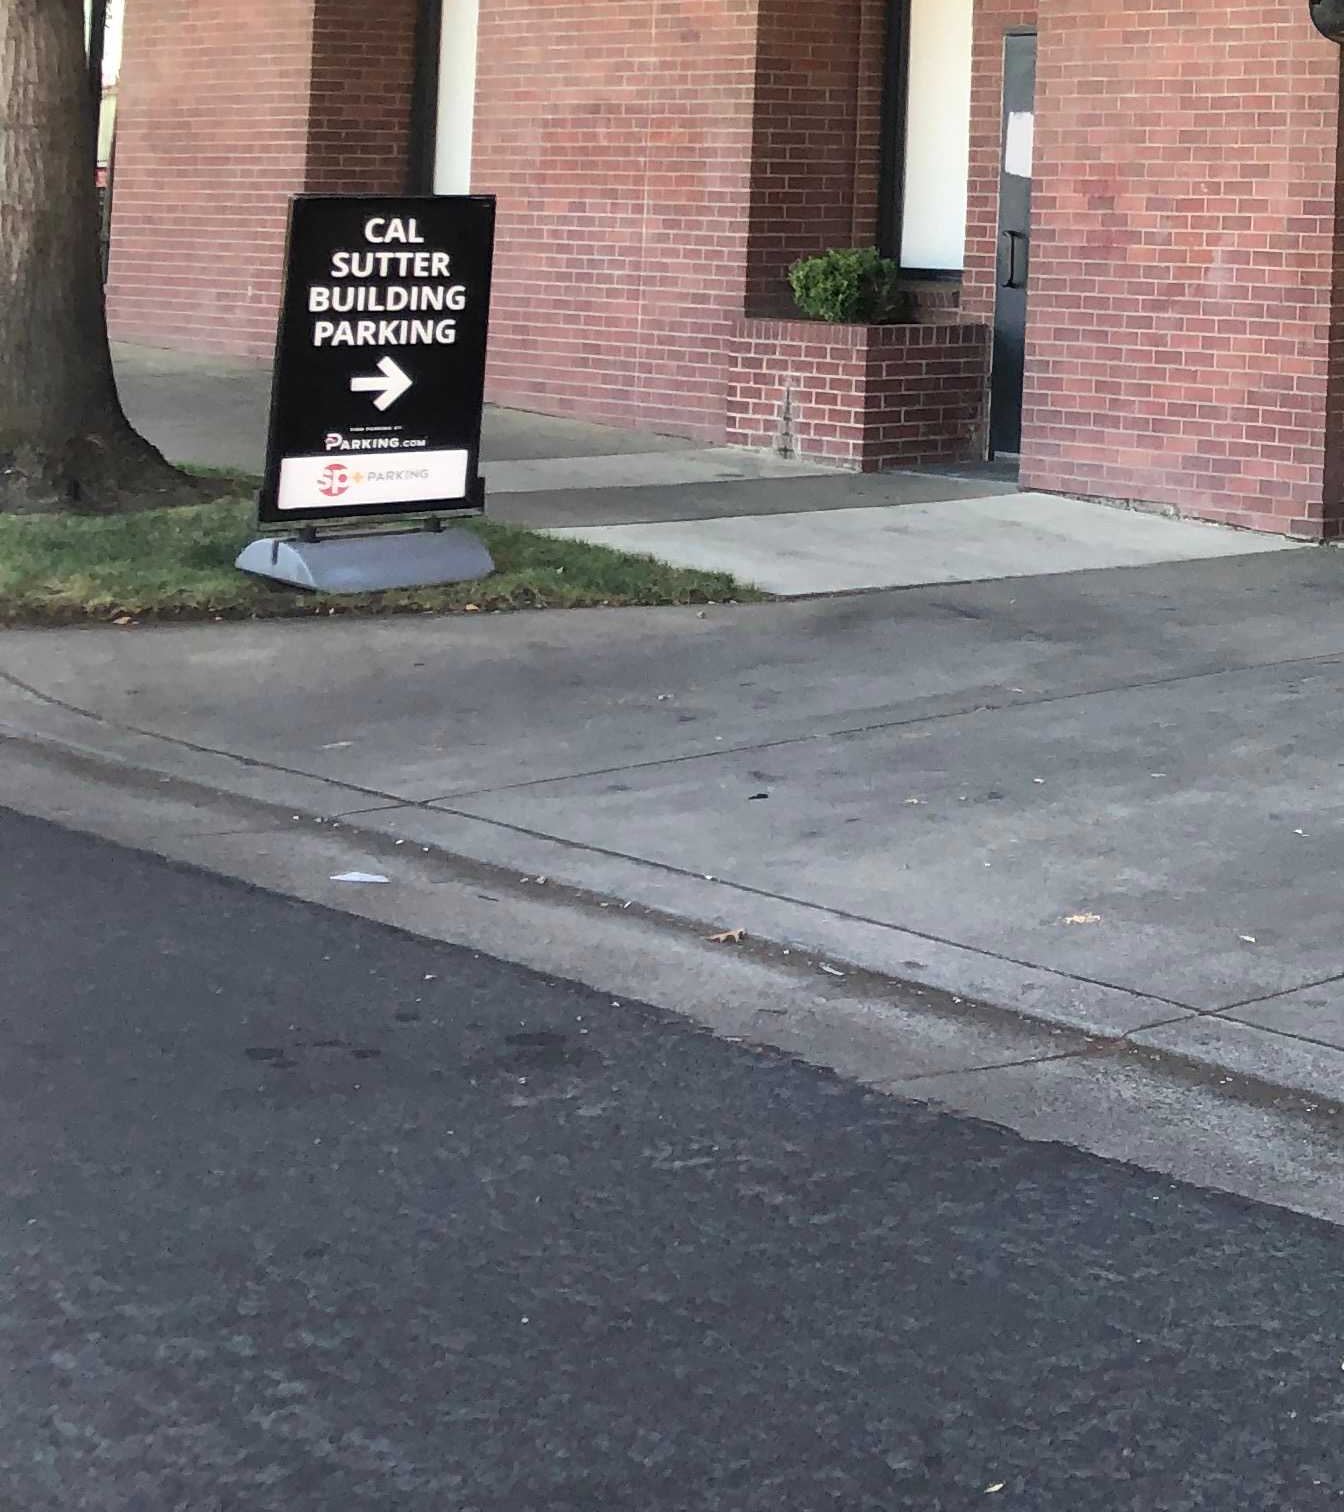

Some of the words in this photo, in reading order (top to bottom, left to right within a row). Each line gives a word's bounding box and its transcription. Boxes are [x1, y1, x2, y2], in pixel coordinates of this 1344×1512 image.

[364, 217, 425, 244] CAL
[330, 251, 451, 278] SUTTER
[308, 285, 467, 313] BUILDING
[313, 319, 457, 347] PARKING
[367, 469, 430, 482] PARKING
